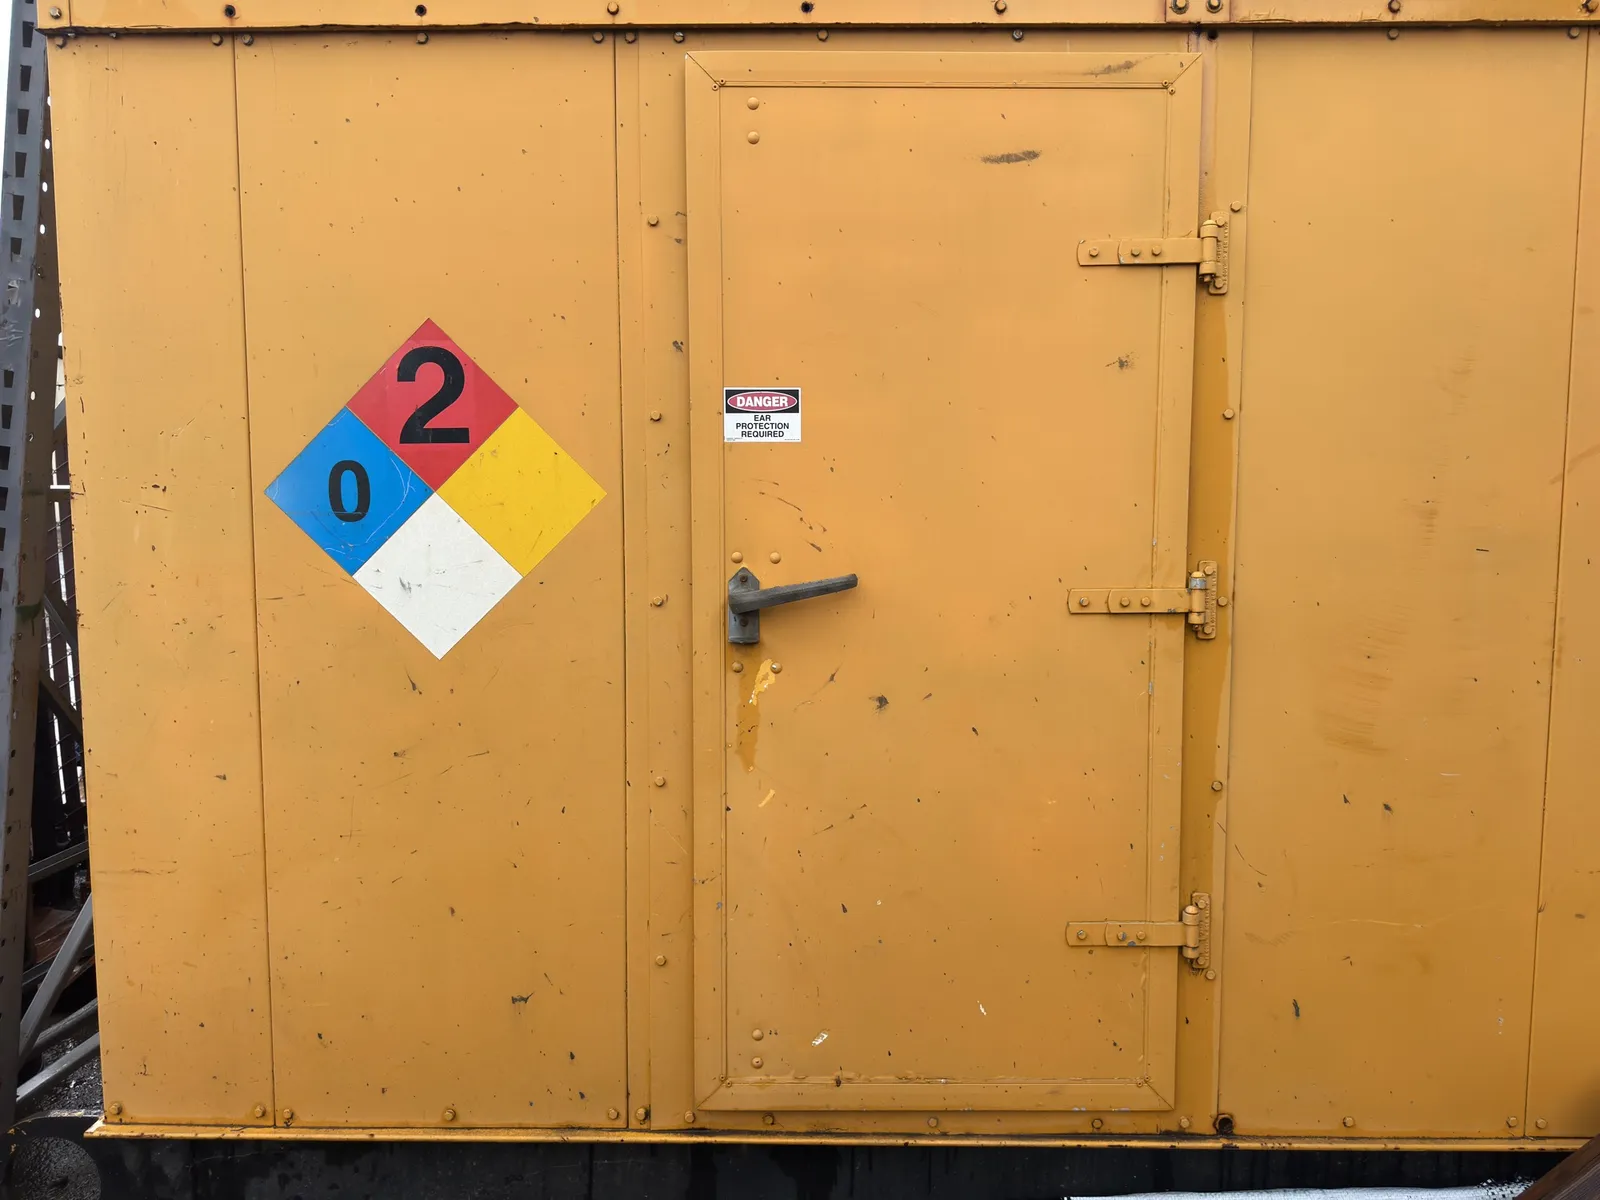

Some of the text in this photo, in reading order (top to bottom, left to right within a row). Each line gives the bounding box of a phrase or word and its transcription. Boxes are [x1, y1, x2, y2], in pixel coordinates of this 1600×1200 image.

[397, 346, 470, 444] 2
[736, 396, 788, 407] DANGER
[328, 460, 371, 522] 0
